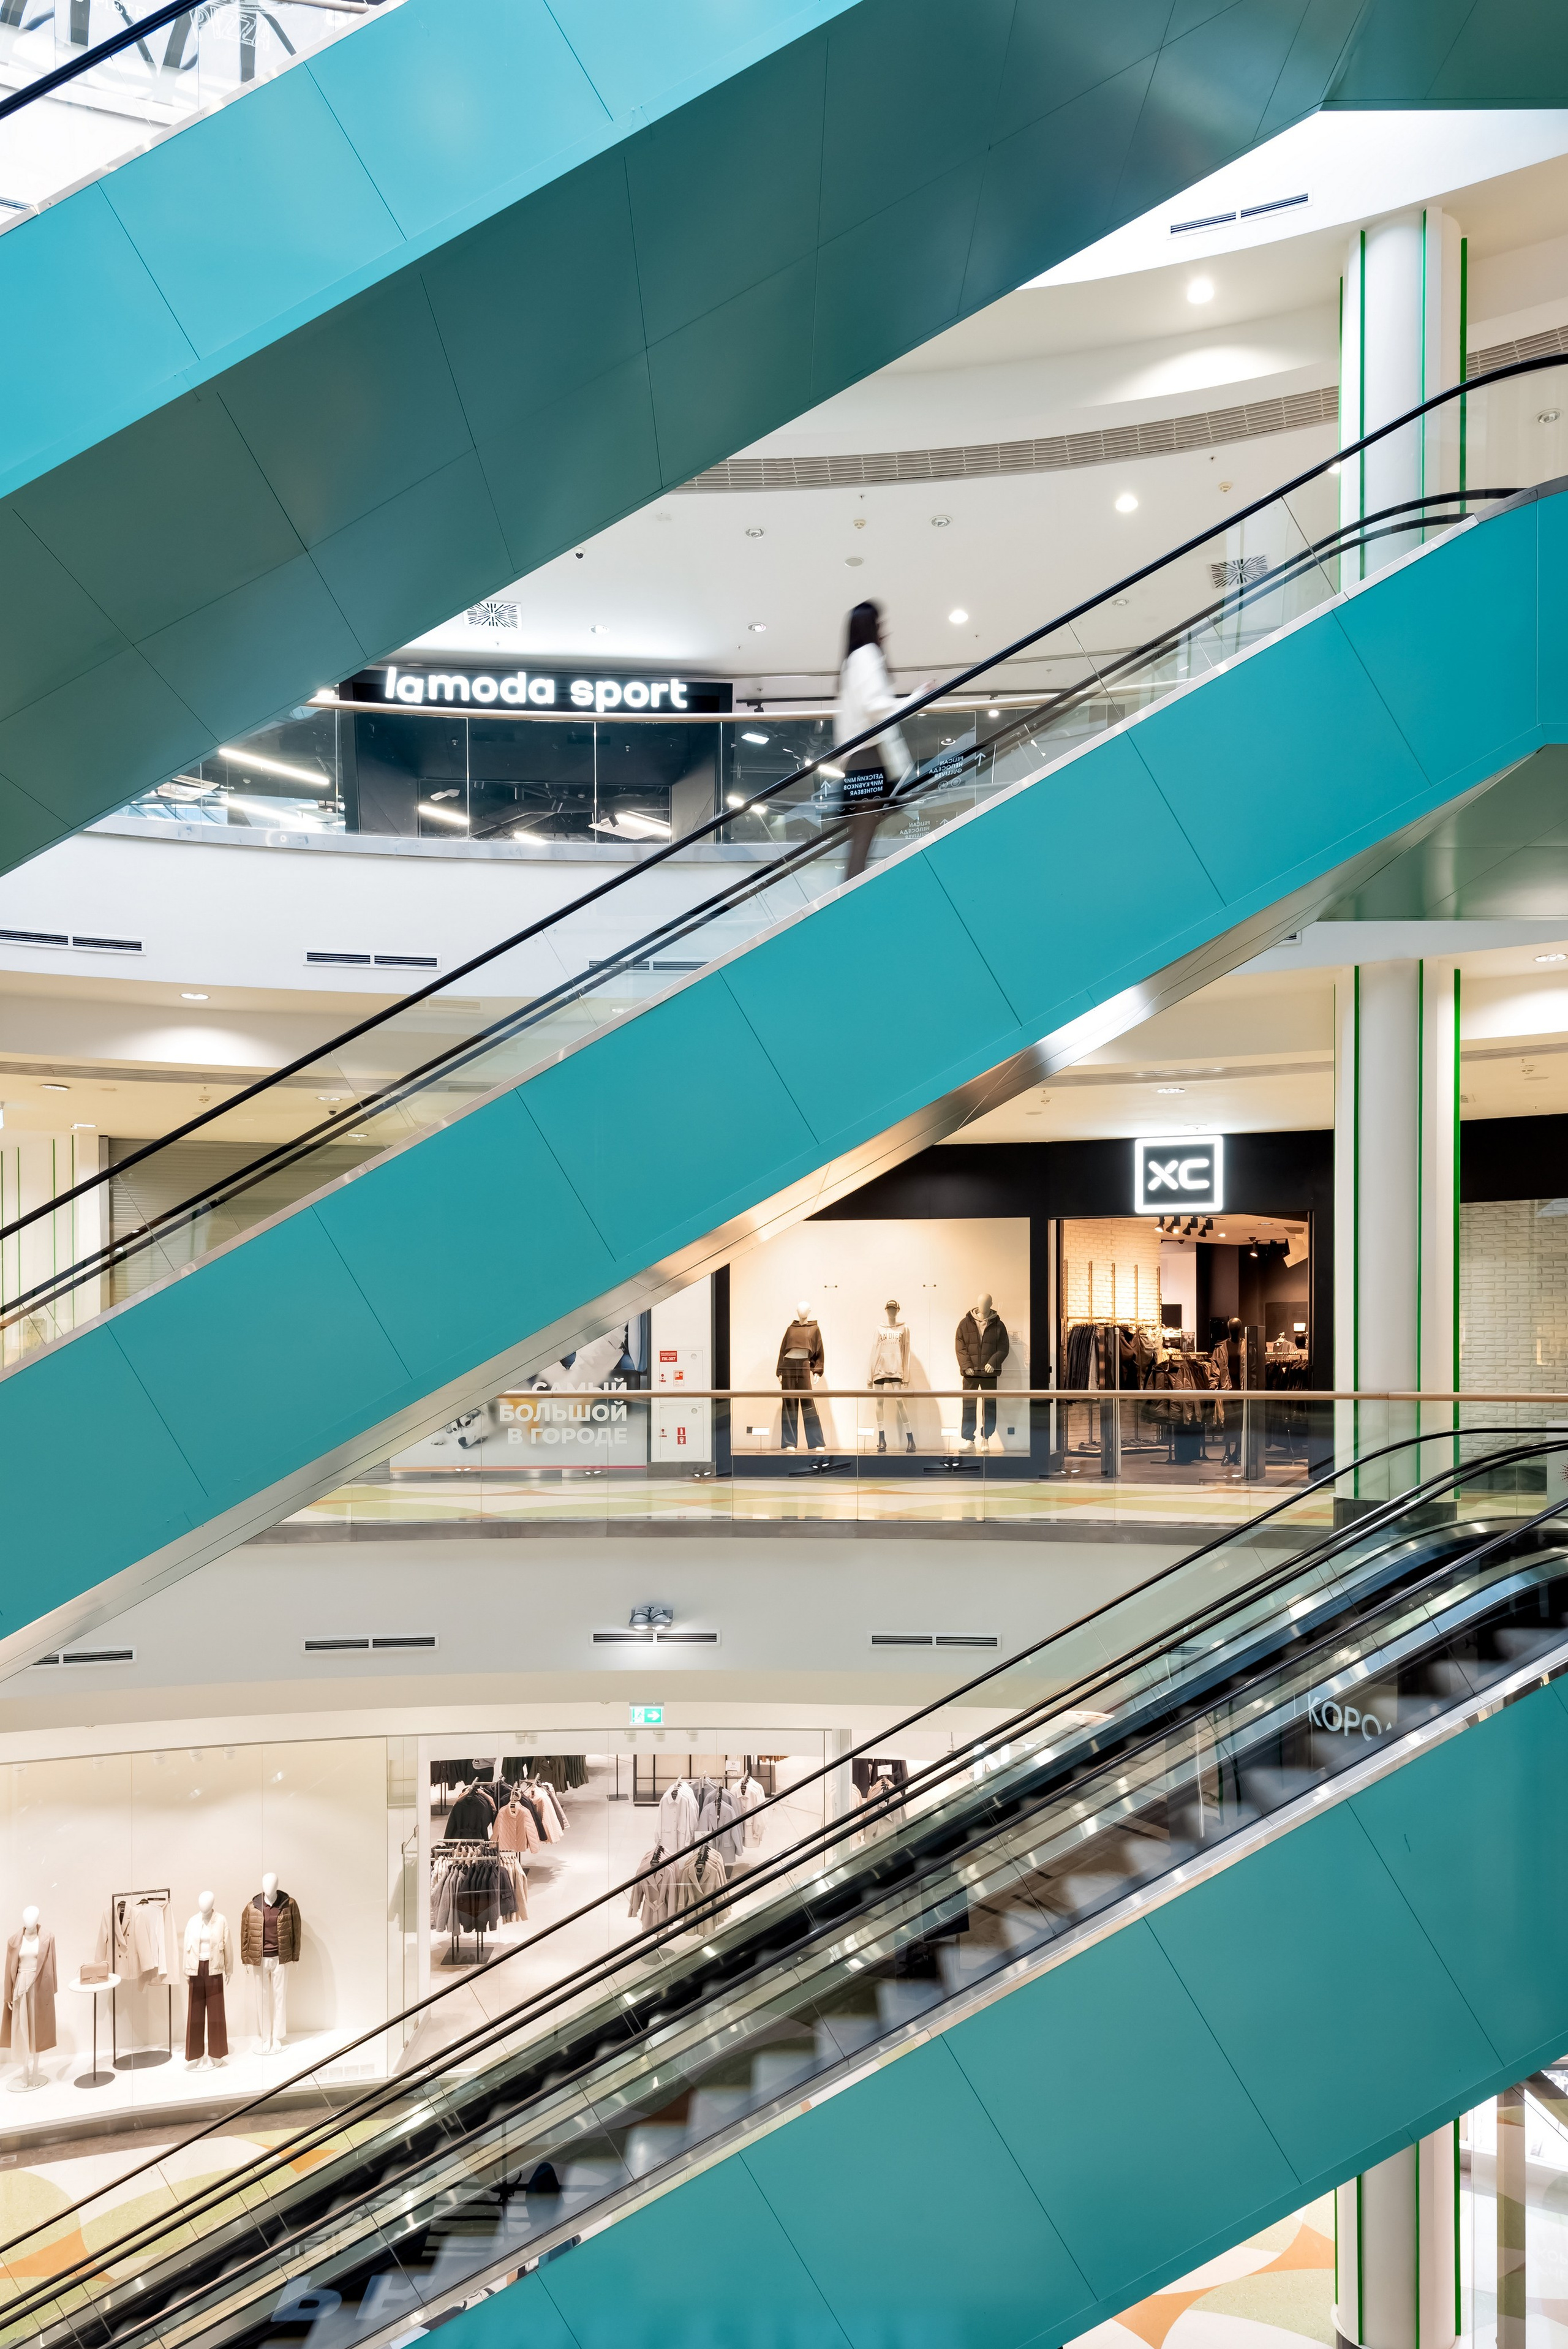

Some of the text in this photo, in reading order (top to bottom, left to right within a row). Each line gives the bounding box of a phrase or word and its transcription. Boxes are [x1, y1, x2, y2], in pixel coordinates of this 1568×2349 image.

[385, 666, 687, 712] lamoda sport
[499, 1400, 627, 1422] БОЛЬШОЙ
[508, 1427, 627, 1447] В ГОРОДЕ
[1307, 1693, 1392, 1742] КОРО
